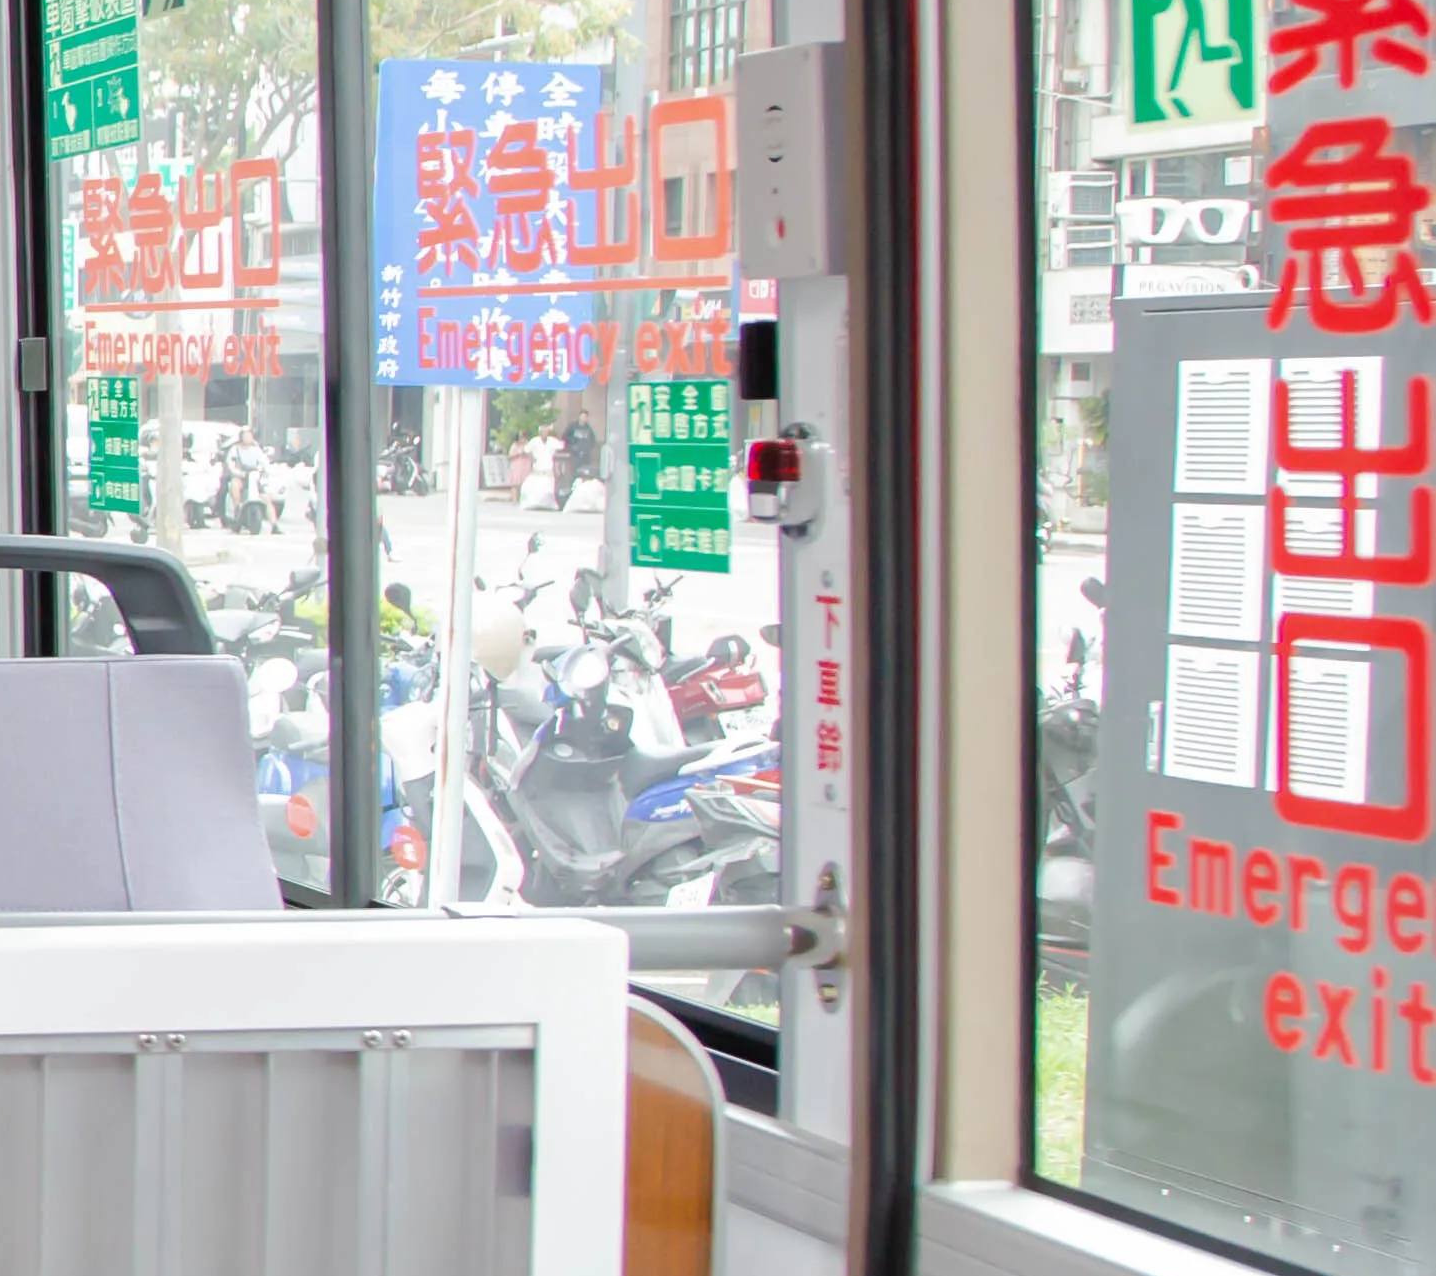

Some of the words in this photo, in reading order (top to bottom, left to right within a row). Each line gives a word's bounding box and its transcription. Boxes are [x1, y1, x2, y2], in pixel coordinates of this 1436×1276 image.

[82, 157, 281, 296] 緊急出口
[416, 95, 733, 277] 緊急出口
[85, 320, 214, 384] Emergency
[224, 314, 283, 376] exit
[376, 264, 404, 379] 新竹市政府
[417, 306, 621, 385] Emergency
[634, 297, 733, 376] exit
[815, 594, 842, 773] 下車鈴
[1145, 807, 1436, 958] Emerge
[1262, 964, 1436, 1087] exit
